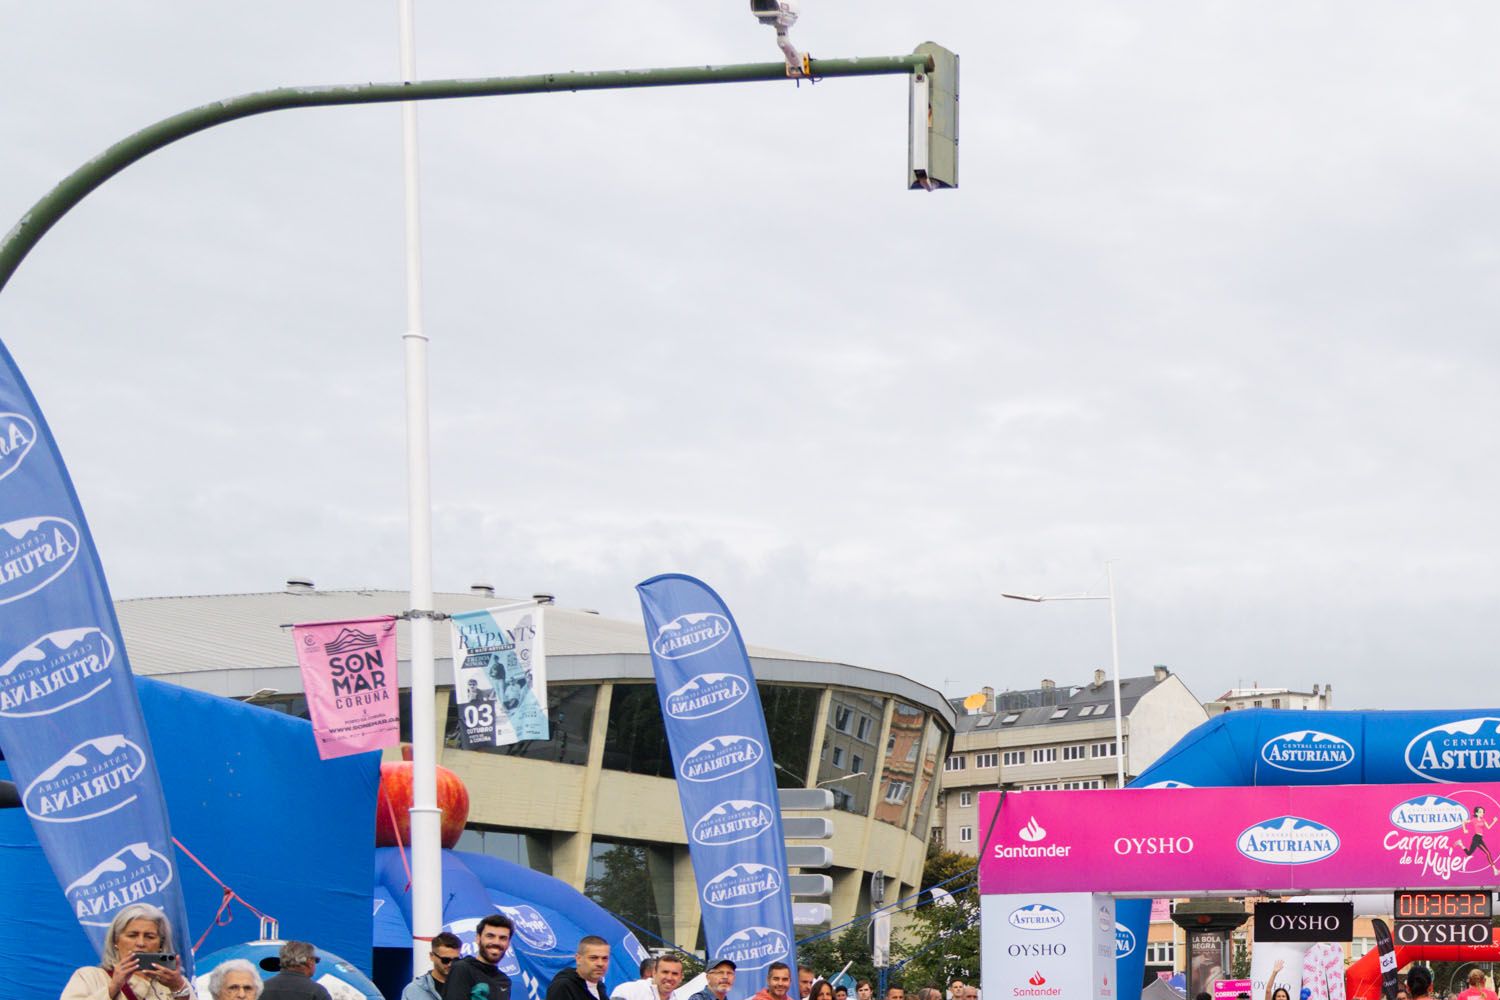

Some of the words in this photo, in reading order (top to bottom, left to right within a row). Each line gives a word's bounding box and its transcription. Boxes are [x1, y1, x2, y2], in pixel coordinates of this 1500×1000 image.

[329, 649, 384, 677] SON
[464, 703, 494, 729] 03
[1443, 737, 1496, 747] CENTRAL
[1268, 742, 1347, 762] ASTURIANA
[1396, 809, 1464, 824] ASTURIANA
[1114, 836, 1194, 855] OYSHO
[1246, 831, 1332, 853] ASTURIANA
[1383, 830, 1449, 851] Carrera
[994, 843, 1071, 858] Santander
[1399, 851, 1412, 865] de
[1414, 851, 1424, 865] la
[1421, 847, 1474, 880] Mujer
[1400, 894, 1486, 916] 00:36:32
[1012, 913, 1061, 925] ASTURIANA
[1269, 914, 1340, 931] OYSHO
[1398, 923, 1489, 944] OYSHO
[1008, 943, 1067, 957] OYSHO
[1013, 987, 1062, 997] Santander
[1252, 980, 1292, 992] OYHO
